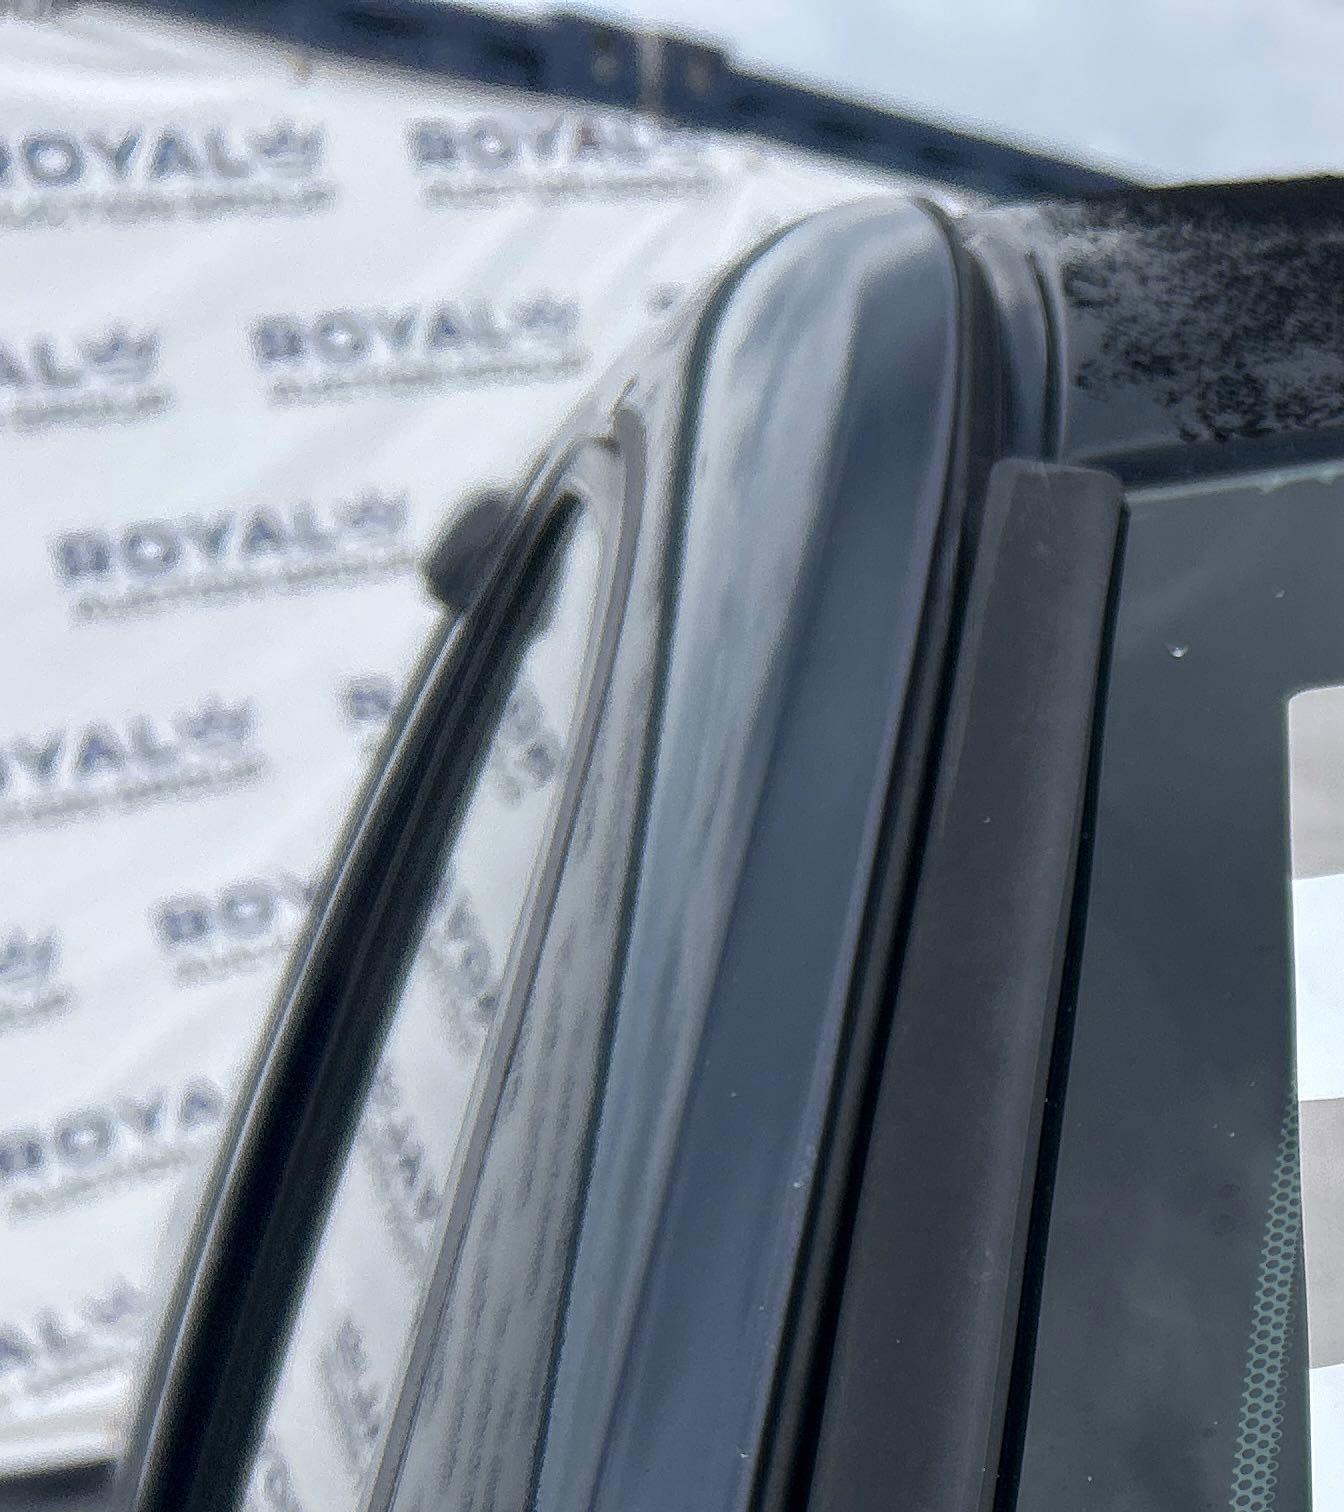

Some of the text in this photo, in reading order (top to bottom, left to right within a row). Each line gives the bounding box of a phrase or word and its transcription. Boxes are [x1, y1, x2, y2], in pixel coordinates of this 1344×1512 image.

[0, 123, 251, 188] OYAL
[252, 300, 508, 368] ROYAL
[55, 502, 336, 584] ROYAL
